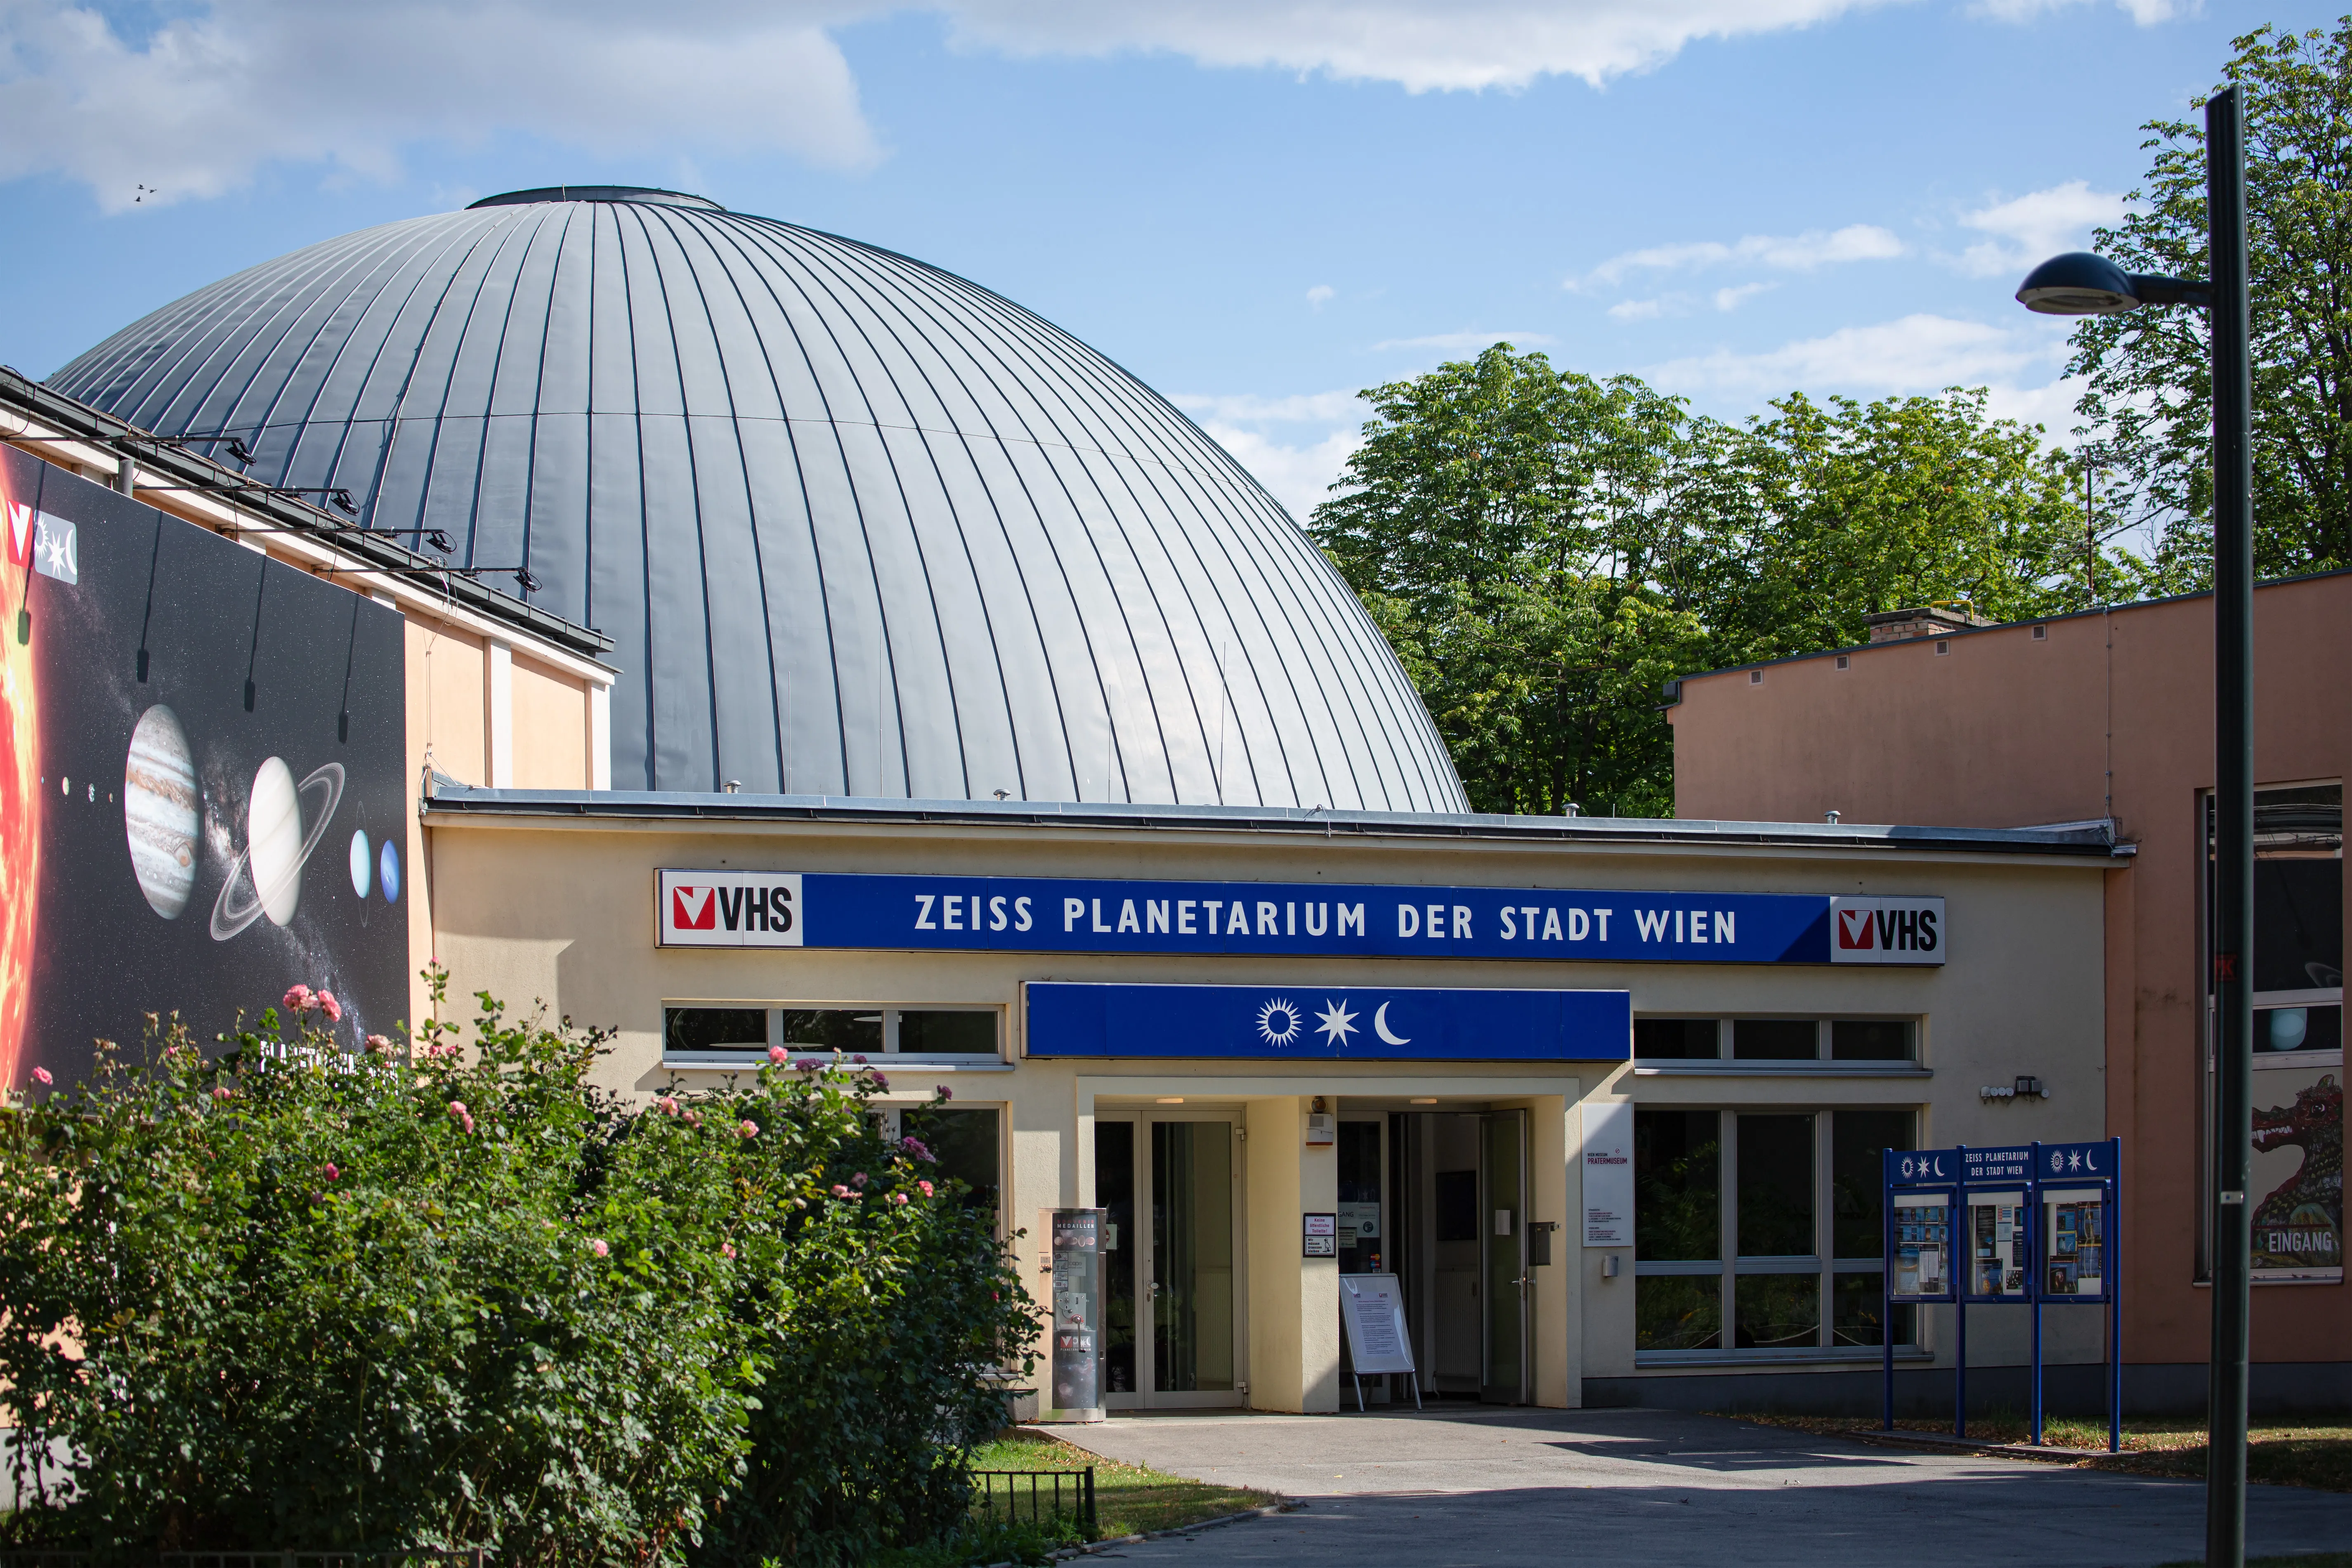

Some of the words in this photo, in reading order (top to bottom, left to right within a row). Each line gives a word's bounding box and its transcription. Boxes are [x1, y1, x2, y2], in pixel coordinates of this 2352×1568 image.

[718, 886, 792, 933] VHS
[914, 895, 1033, 932] ZEISS
[1064, 898, 1365, 936] PLANETARIUM
[1398, 904, 1473, 938] DER
[1500, 907, 1612, 941] STADT
[1634, 909, 1735, 943] WIEN
[1877, 909, 1937, 952] VHS
[1965, 1153, 1982, 1162] ZEISS
[1986, 1152, 2028, 1162] PLANETARIUM
[1972, 1167, 1983, 1176] DER
[1986, 1167, 2004, 1175] STADT
[2007, 1166, 2022, 1174] WIEN
[2269, 1232, 2331, 1252] EINGANG
